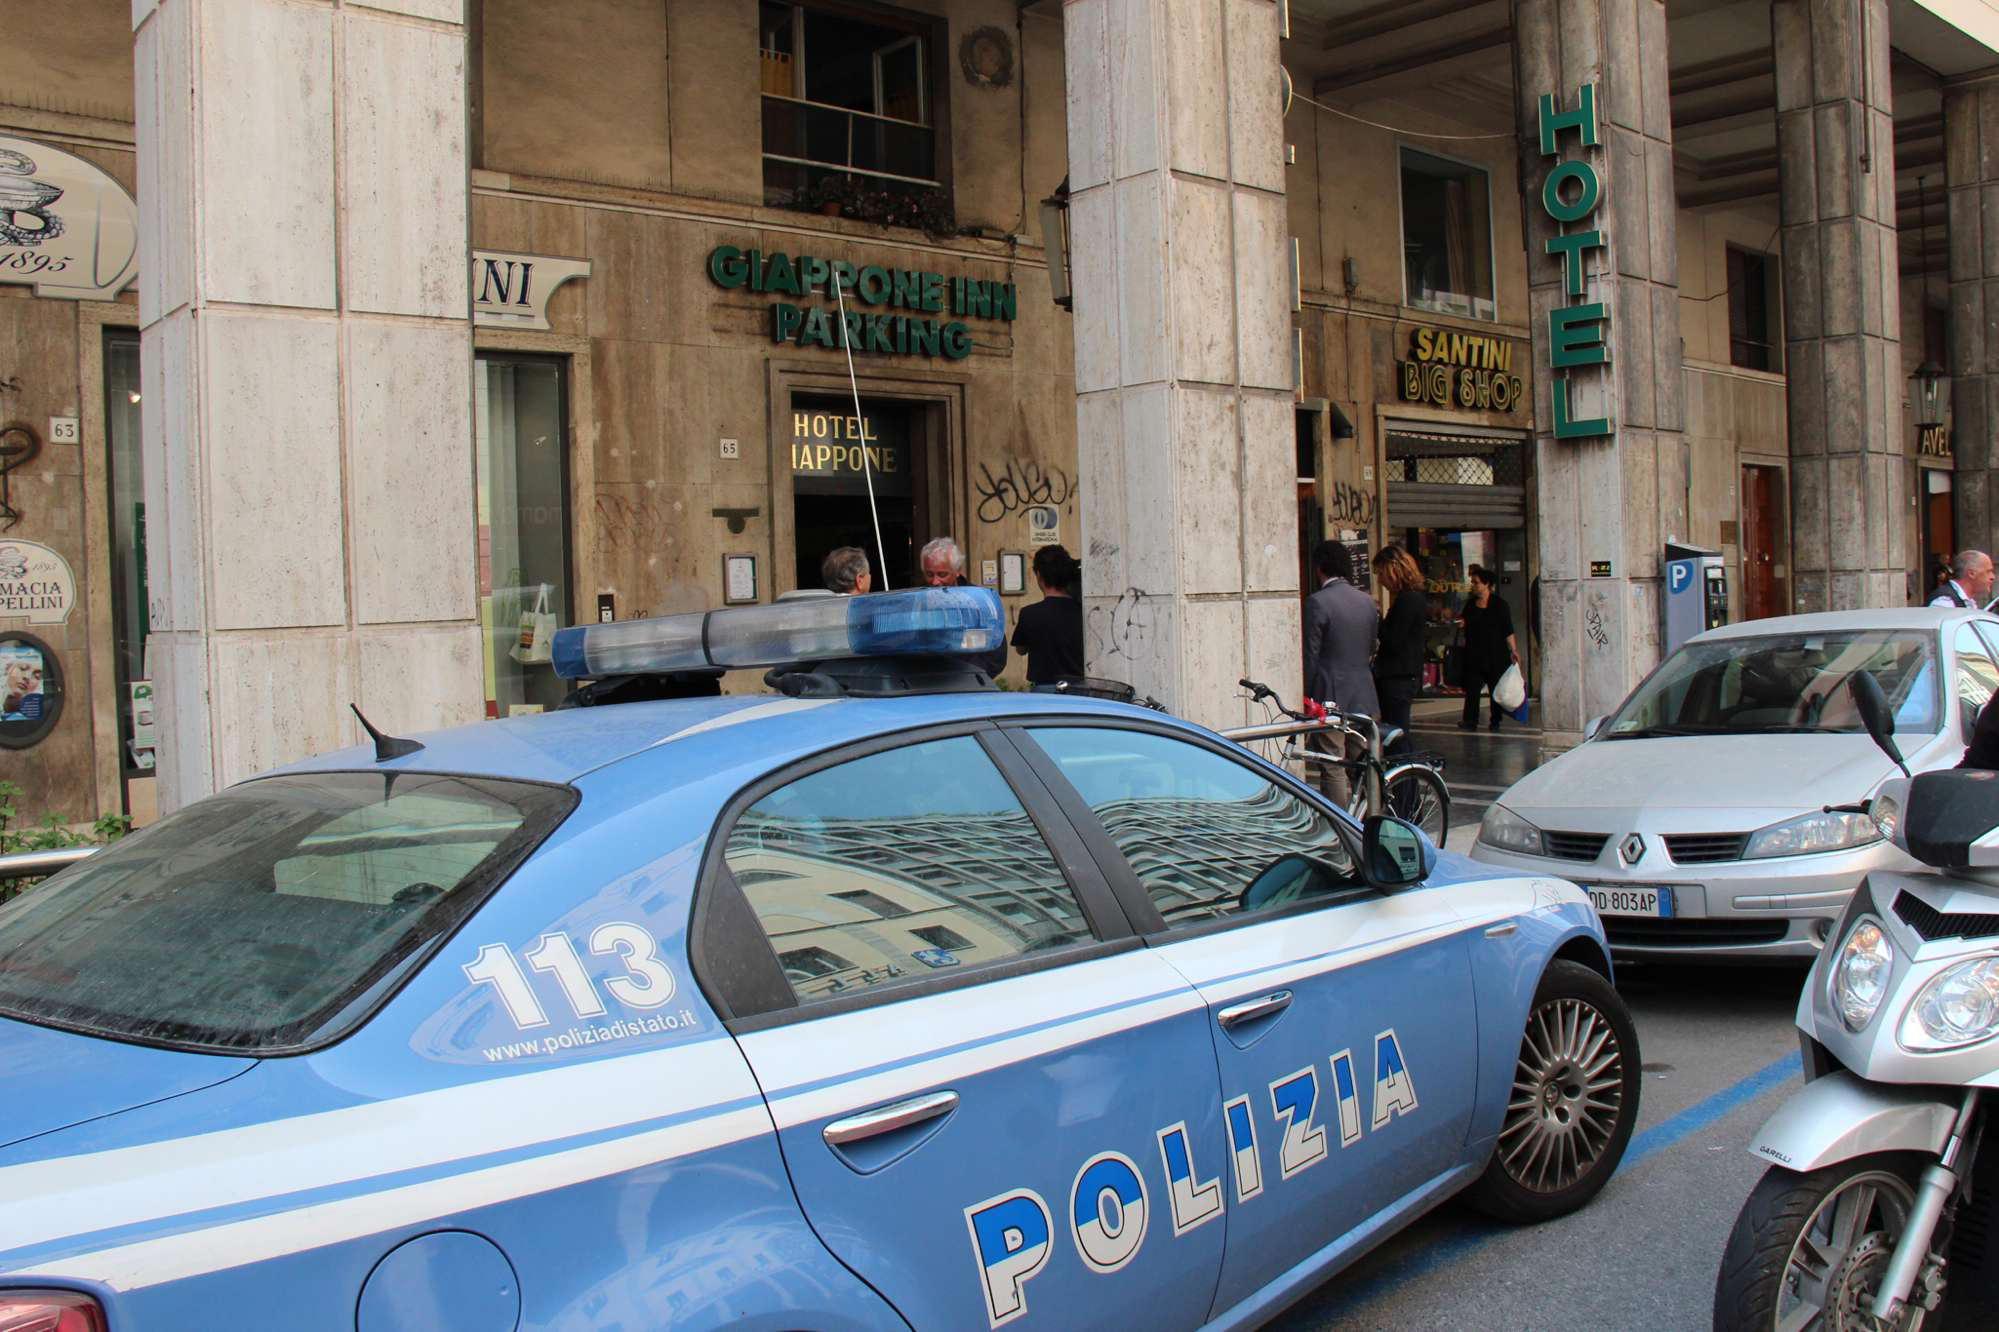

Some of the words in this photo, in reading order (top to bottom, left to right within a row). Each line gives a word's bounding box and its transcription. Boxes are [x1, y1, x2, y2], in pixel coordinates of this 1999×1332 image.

[473, 258, 535, 307] NI
[706, 245, 944, 312] GIAPPONE
[949, 275, 1016, 320] INN
[1538, 83, 1615, 440] HOTEL
[770, 302, 973, 361] PARKING
[1412, 326, 1513, 372] SANTINI
[1401, 361, 1450, 406] BIG
[1457, 368, 1522, 412] SHOP
[55, 423, 74, 438] 63
[723, 442, 737, 454] 65
[794, 413, 878, 441] HOTEL
[1671, 564, 1687, 589] P
[461, 921, 677, 1031] 113
[483, 1009, 697, 1063] www.poliziadistato.it
[963, 1028, 1419, 1330] POLIZIA
